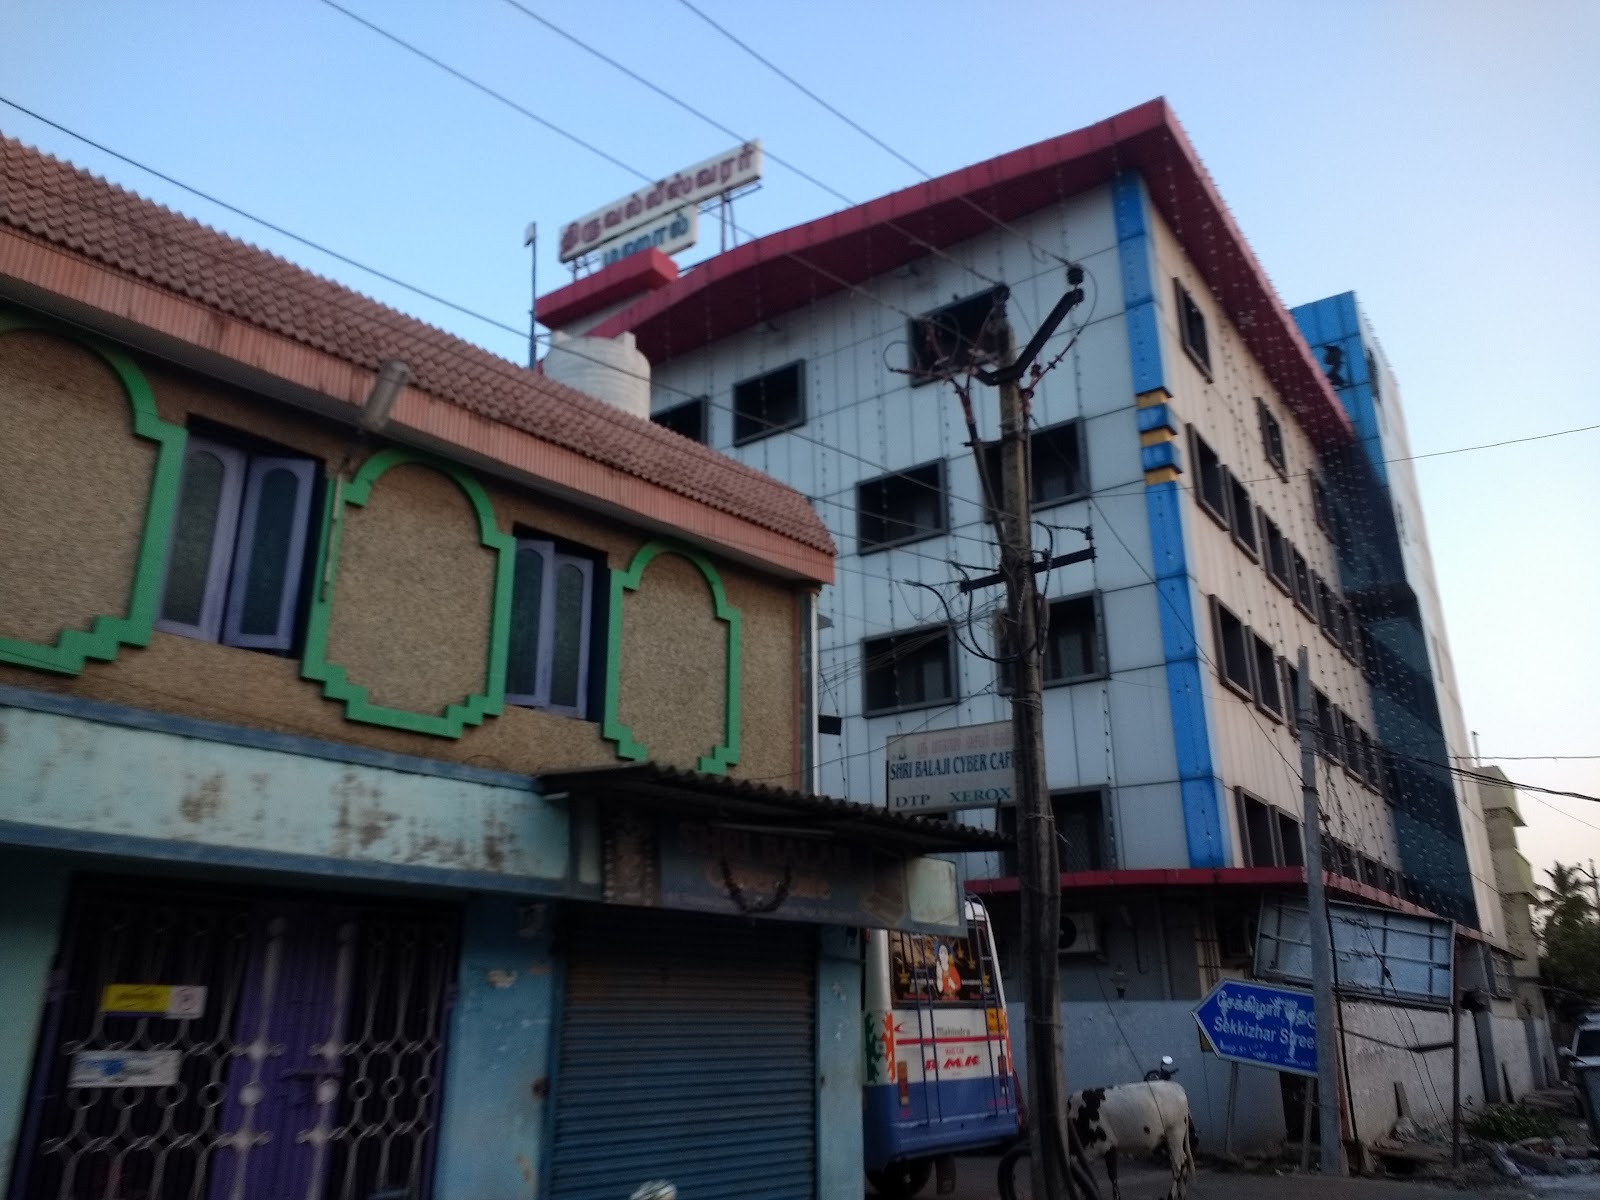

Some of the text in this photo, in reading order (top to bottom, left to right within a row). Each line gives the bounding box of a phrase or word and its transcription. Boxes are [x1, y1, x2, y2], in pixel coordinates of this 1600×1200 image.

[890, 761, 912, 780] SHRI
[915, 757, 950, 778] BALAJI
[953, 753, 987, 774] CYBER
[896, 787, 1011, 808] DTP XEROX
[1214, 1015, 1316, 1050] Sekkizhar Stree
